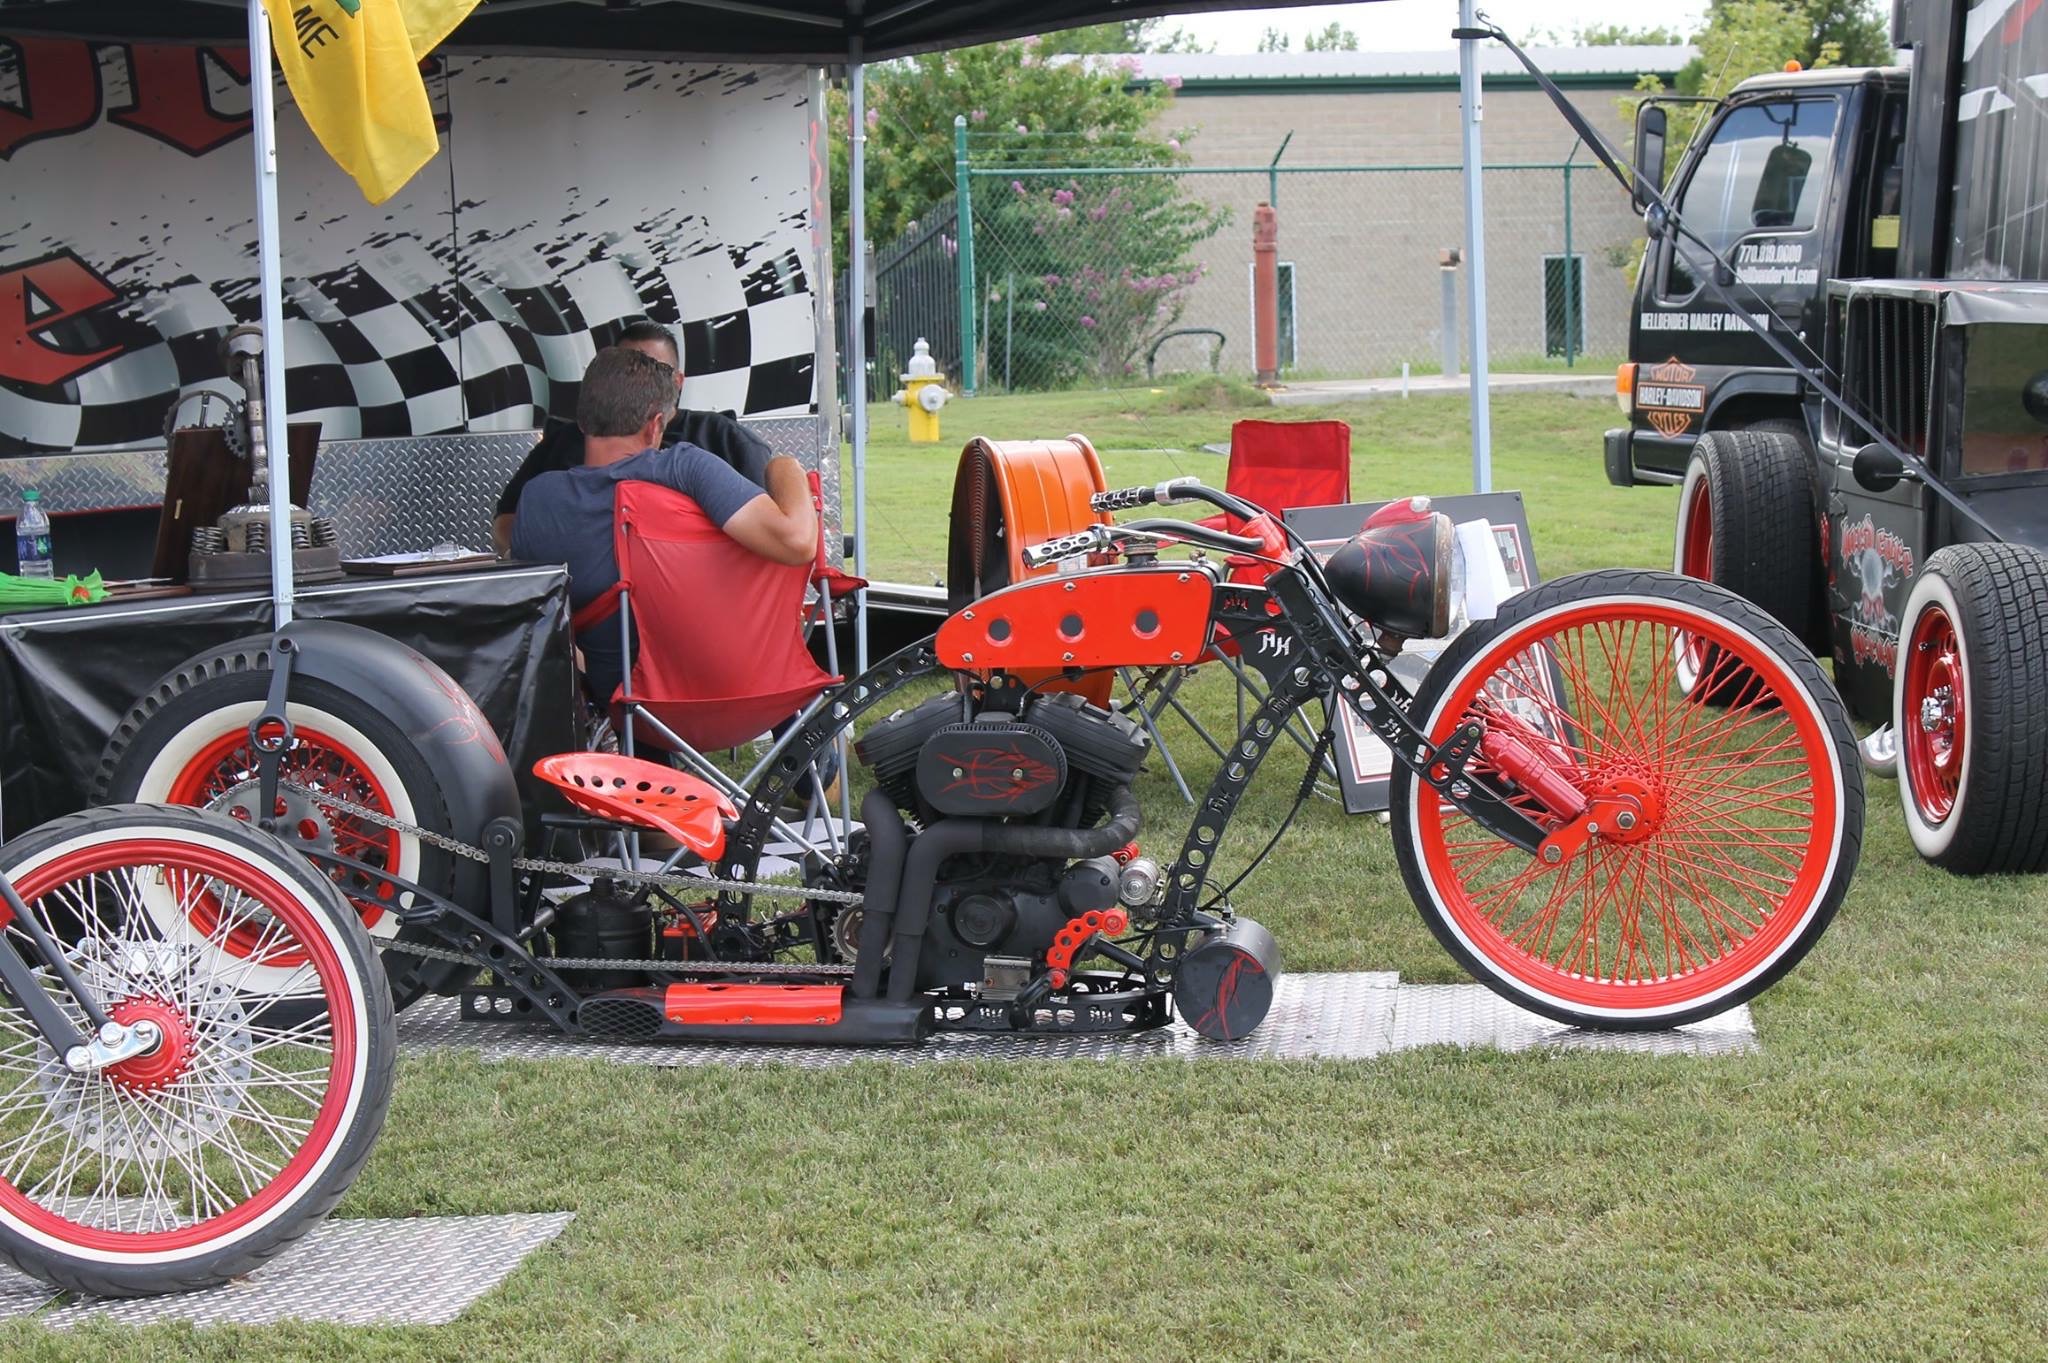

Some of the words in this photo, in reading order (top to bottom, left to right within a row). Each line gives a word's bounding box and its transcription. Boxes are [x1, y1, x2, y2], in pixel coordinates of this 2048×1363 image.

[293, 5, 339, 59] ME
[1689, 313, 1723, 331] HARLEY
[1723, 313, 1769, 332] DAVION
[1655, 363, 1691, 383] MOTOR
[1639, 386, 1702, 409] HARLEY-DAVIDSON
[1652, 411, 1686, 434] CYCLES
